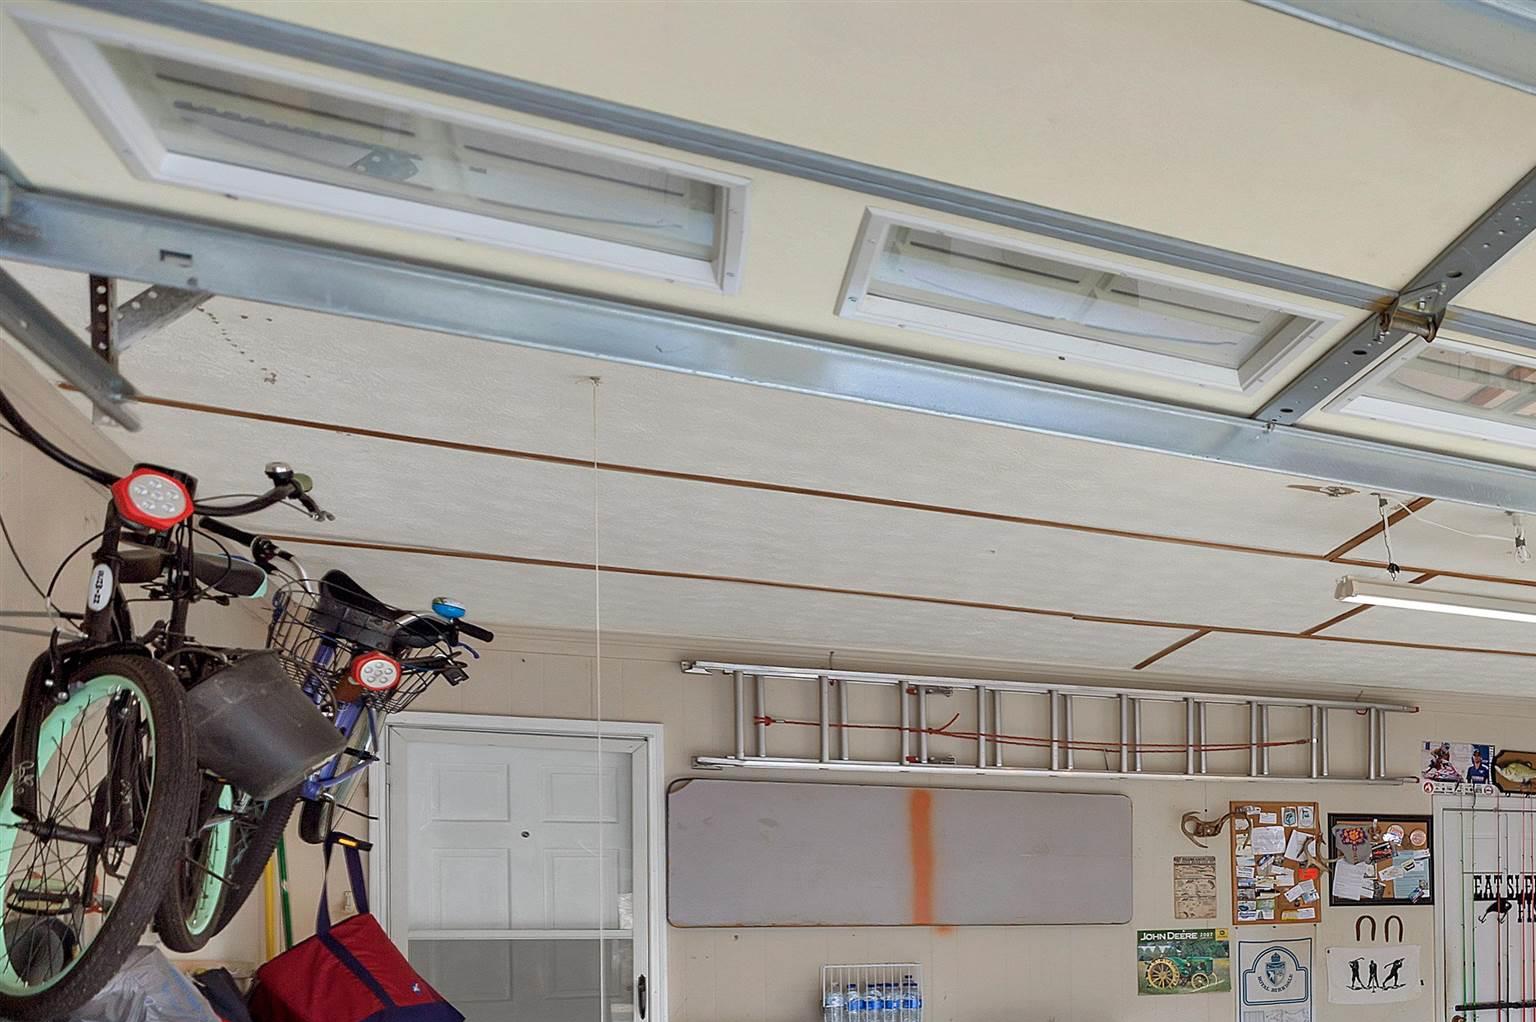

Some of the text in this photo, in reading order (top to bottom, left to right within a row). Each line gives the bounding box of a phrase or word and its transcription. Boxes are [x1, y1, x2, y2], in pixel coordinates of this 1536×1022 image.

[1473, 875, 1502, 900] EAT
[1140, 932, 1166, 940] JOHN
[1167, 931, 1198, 940] DEERE
